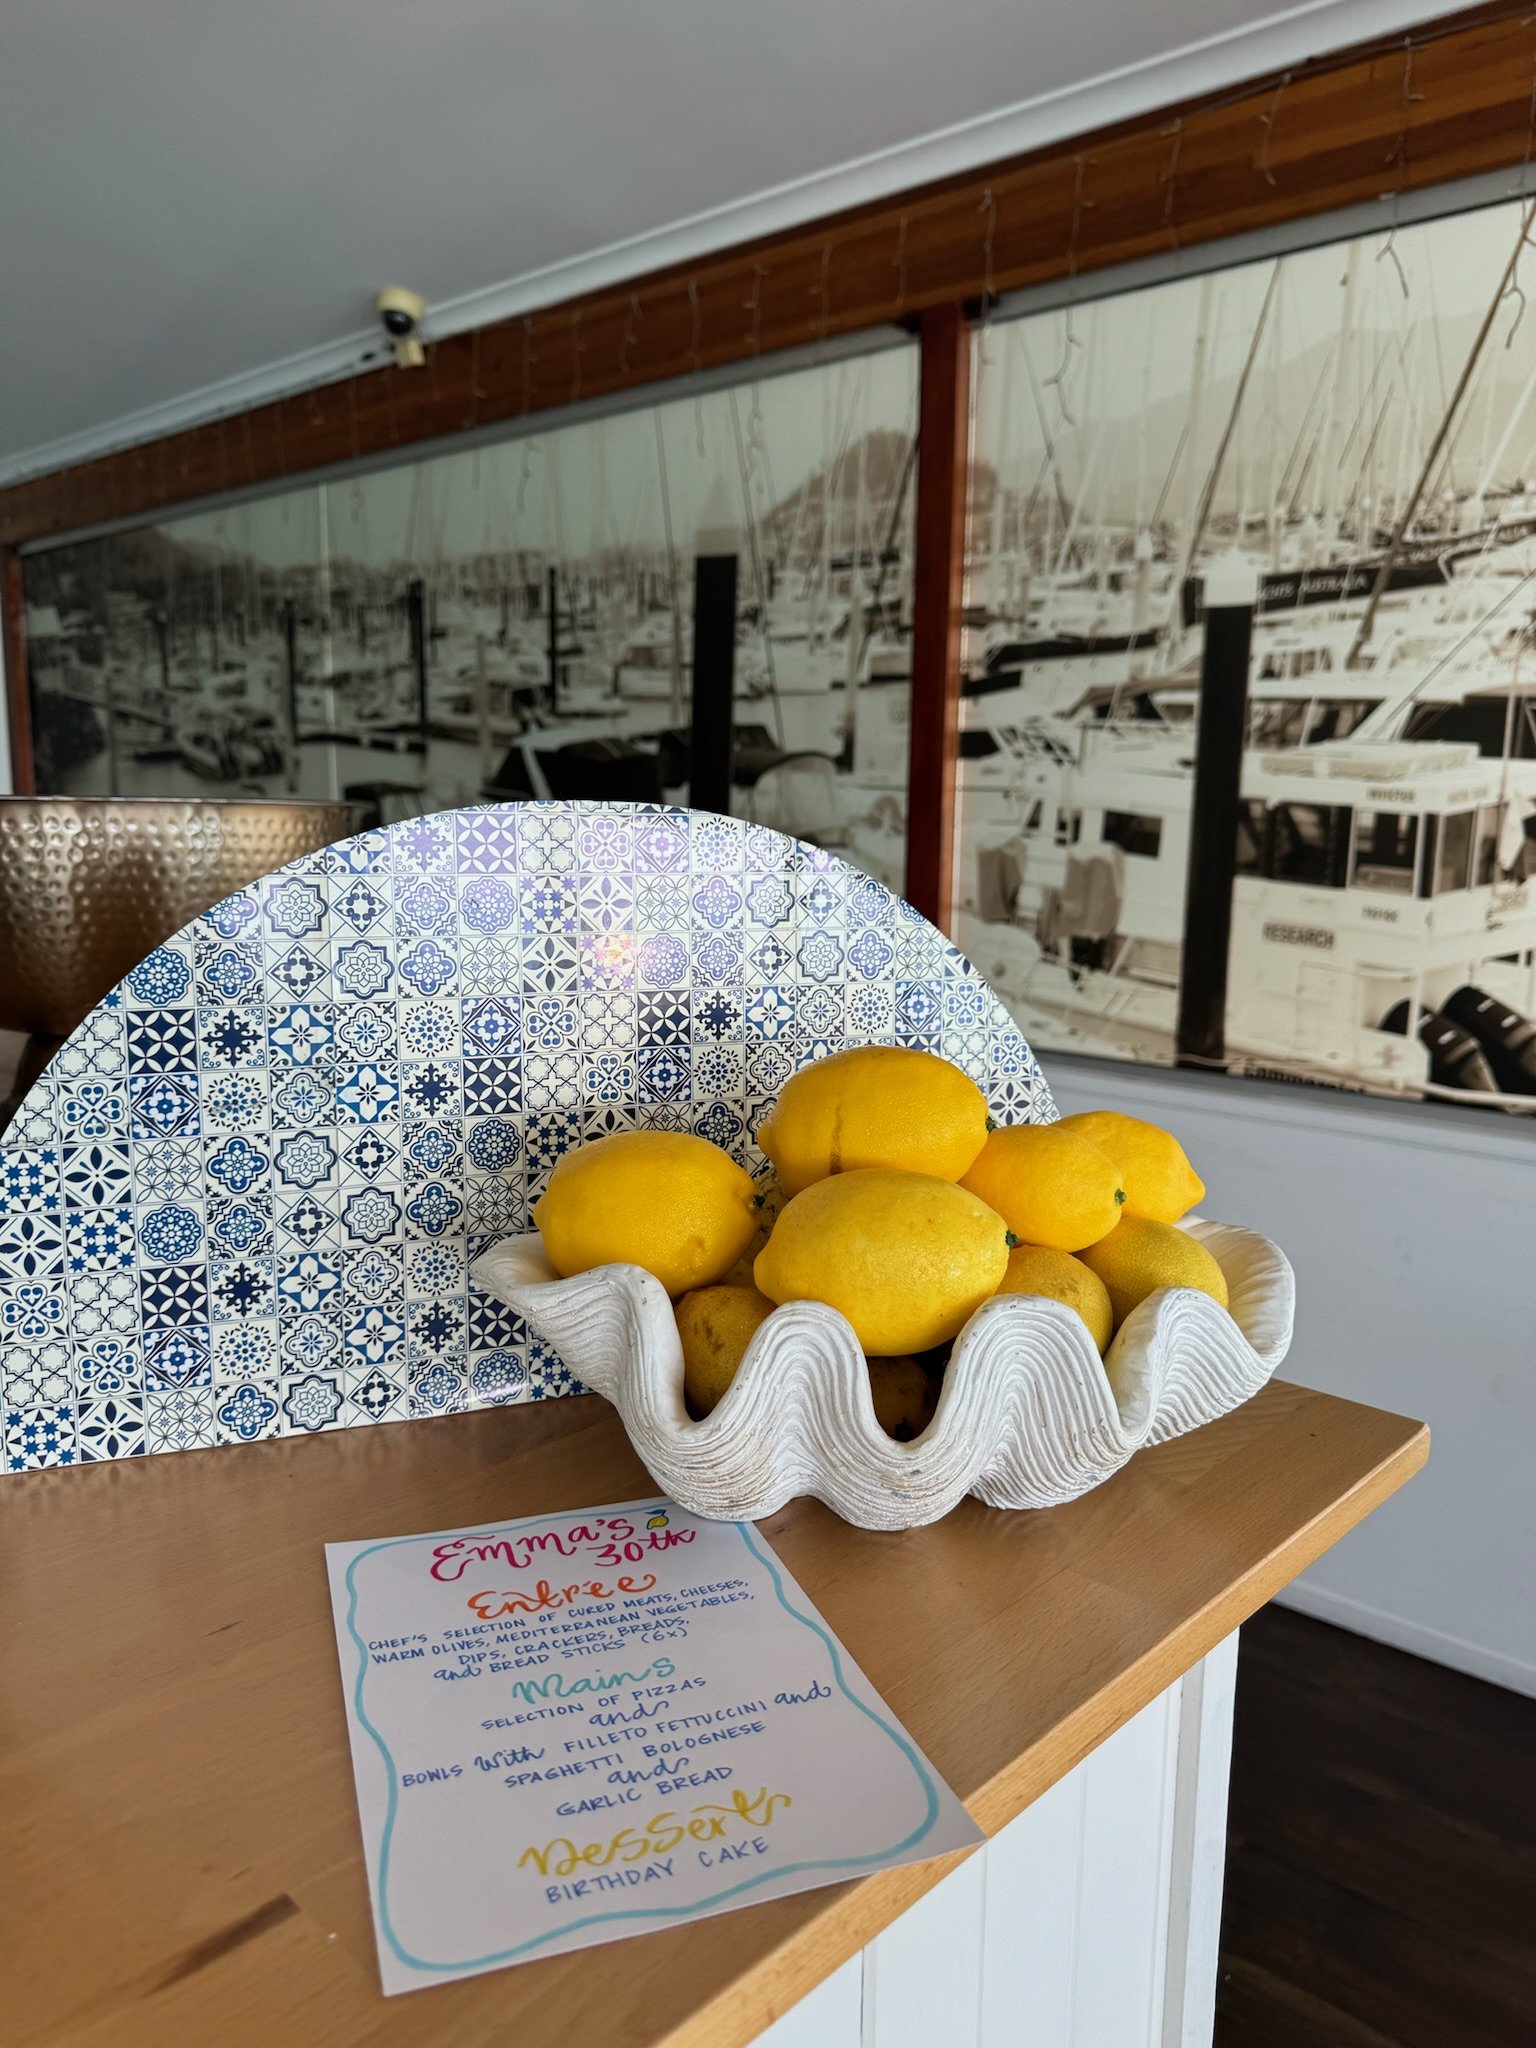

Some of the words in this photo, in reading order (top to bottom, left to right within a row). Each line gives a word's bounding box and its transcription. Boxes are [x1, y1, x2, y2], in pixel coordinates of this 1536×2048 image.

[430, 1517, 635, 1582] Emma's
[585, 1528, 697, 1567] 30th
[368, 1633, 428, 1651] CHEF'S
[443, 1618, 526, 1640] SELECTION
[538, 1611, 557, 1624] OF
[568, 1602, 616, 1619] CURED
[623, 1592, 678, 1608] MEATS,
[680, 1578, 749, 1598] CHEESES,
[371, 1647, 425, 1665] WARM
[431, 1637, 490, 1656] OLIVES,
[495, 1611, 641, 1645] MEDITERRANEAN
[645, 1590, 755, 1617] VEGETABLES,
[433, 1663, 482, 1681] and
[489, 1653, 550, 1674] BREAD
[561, 1639, 626, 1659] STICKS
[458, 1649, 506, 1666] DIPS,
[514, 1631, 614, 1656] CRACKERS,
[481, 1702, 585, 1731] SELECTION
[597, 1694, 621, 1708] OF
[631, 1676, 707, 1701] PIZZAS
[512, 1657, 676, 1705] Mains
[402, 1763, 464, 1788] BOWLS
[563, 1726, 648, 1753] FILLETO
[656, 1700, 768, 1734] FETTUCCINI
[774, 1680, 832, 1705] and
[588, 1700, 670, 1726] and
[503, 1752, 624, 1789] SPAGHETTI
[642, 1720, 767, 1758] BOLOGNESE
[607, 1757, 690, 1785] and
[555, 1787, 643, 1817] GARLIC
[655, 1766, 734, 1796] BREAD
[516, 1786, 793, 1877] Dessert
[545, 1857, 675, 1905] BIRTHDAY
[697, 1835, 770, 1868] CAKE
